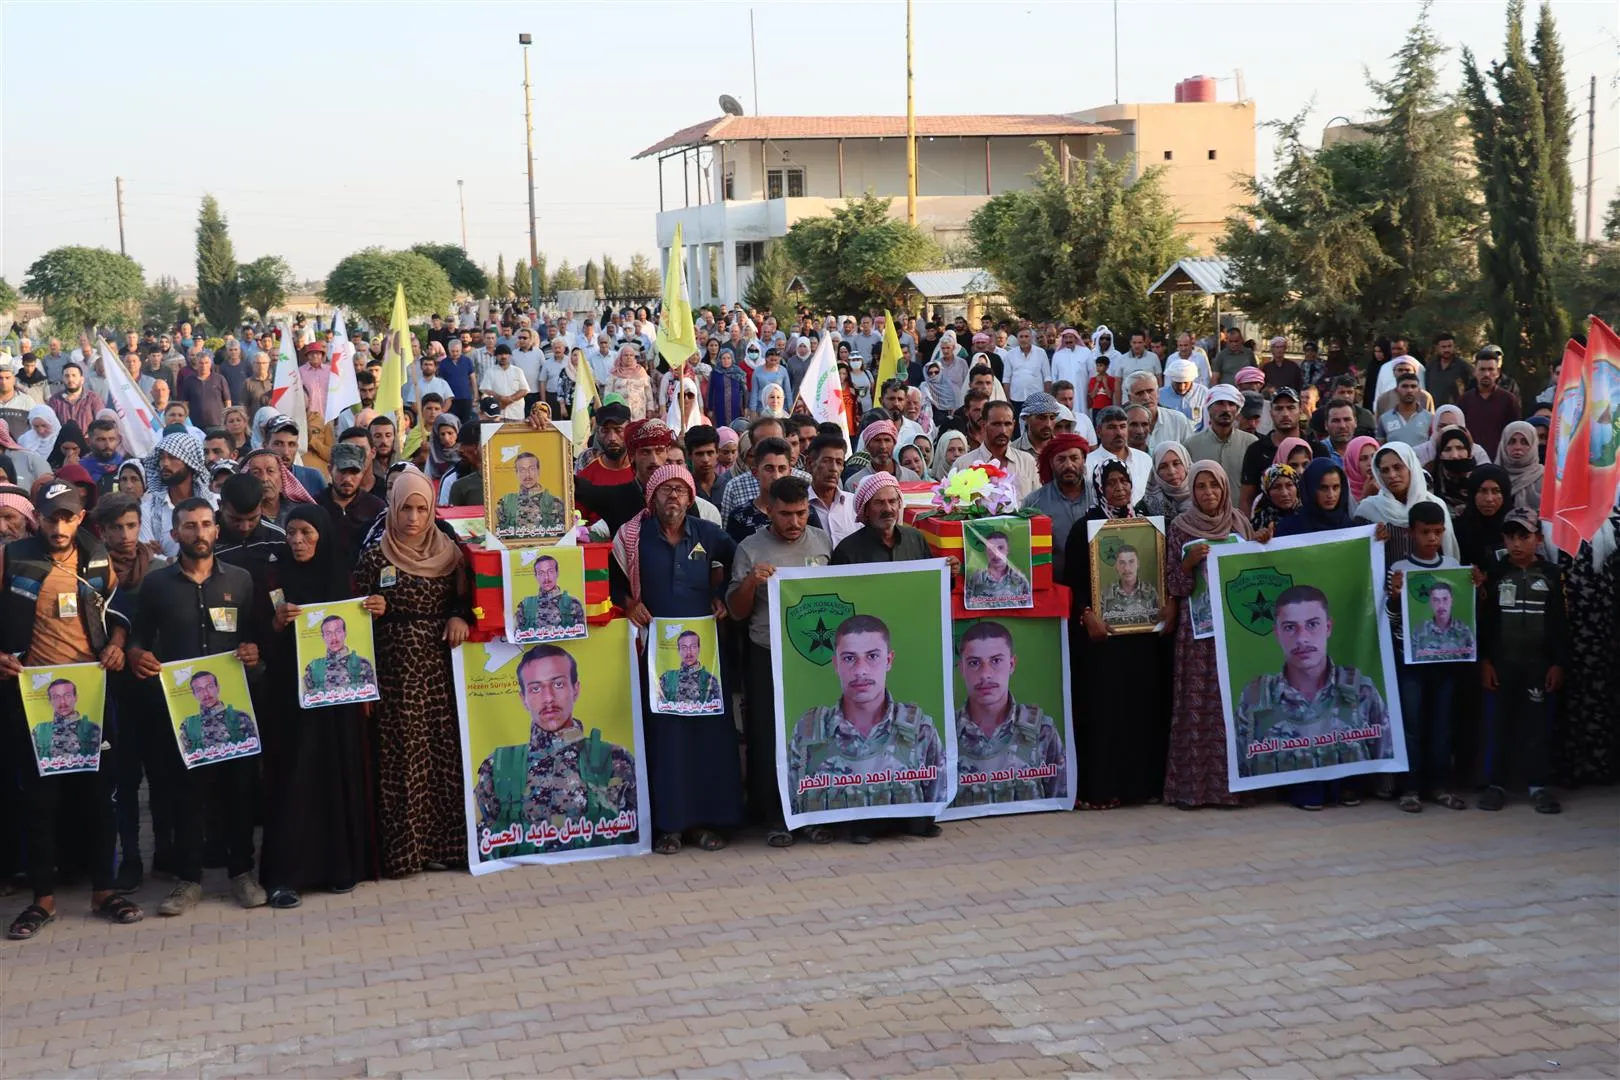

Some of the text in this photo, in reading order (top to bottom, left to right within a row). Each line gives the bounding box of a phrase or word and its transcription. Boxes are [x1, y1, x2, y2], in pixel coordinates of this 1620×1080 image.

[1247, 722, 1381, 759] الشهيد احمد محمد الخضر
[797, 763, 937, 794] الشهيد احمد محمد الخضر
[959, 761, 1057, 785] الشهيد احمد محمد
[481, 811, 637, 854] الشهيد باسل عايد الحسن
